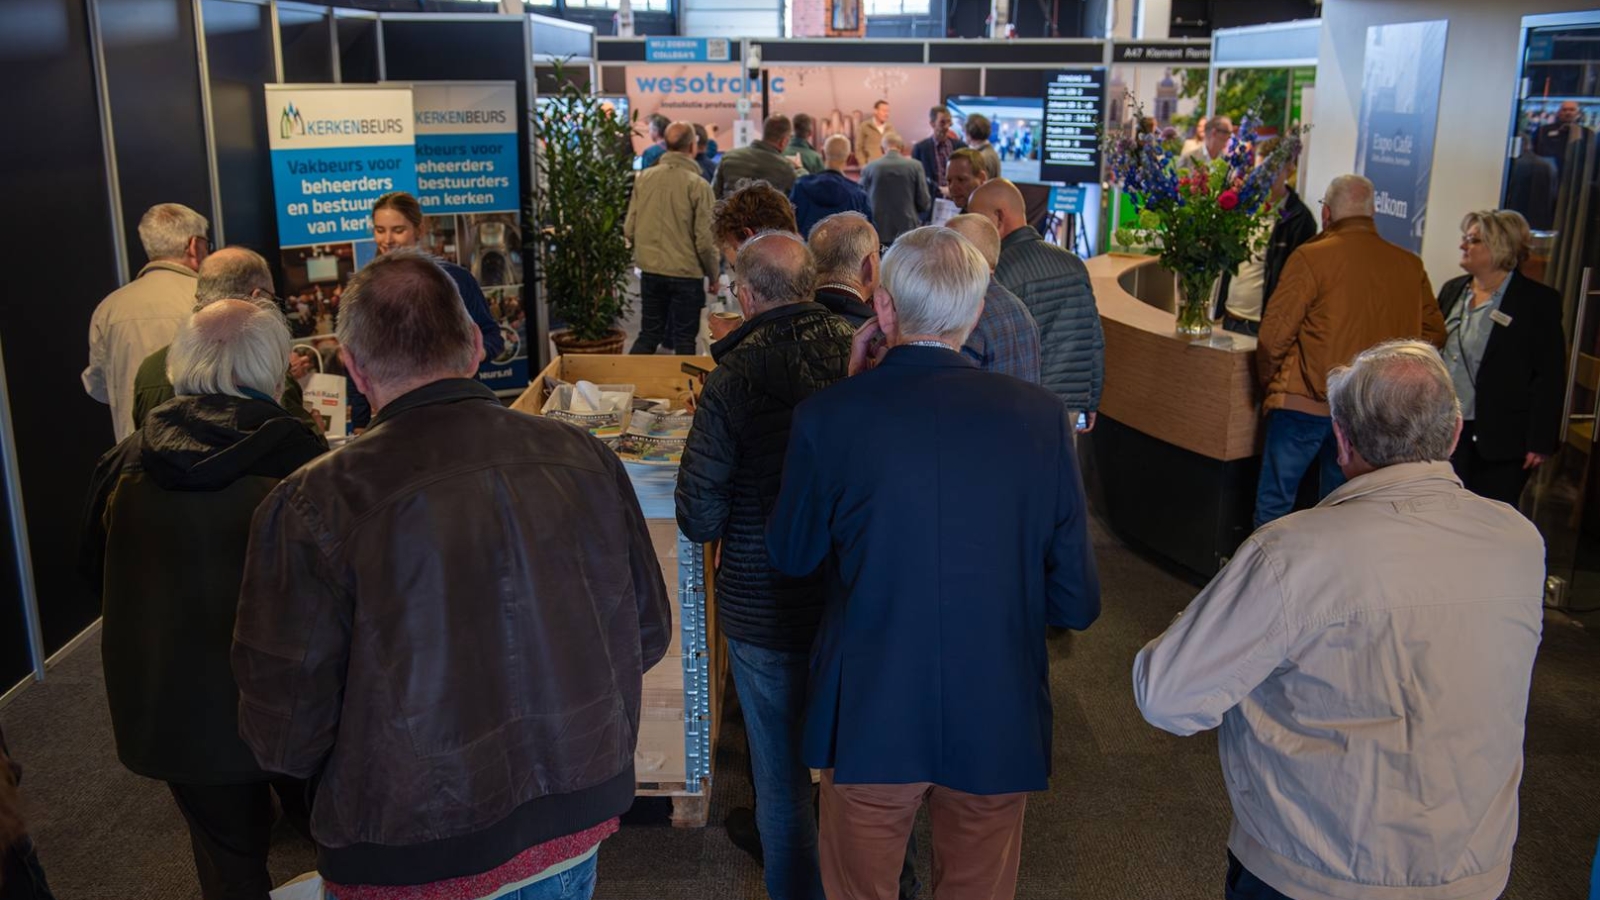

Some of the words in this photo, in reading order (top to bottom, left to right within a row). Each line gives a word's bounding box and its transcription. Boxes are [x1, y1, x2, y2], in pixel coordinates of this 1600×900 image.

[636, 71, 785, 94] wesotronc
[414, 110, 507, 124] KERKENBEURS
[307, 118, 404, 136] KERKENBEURS
[415, 144, 467, 156] kbeurs
[471, 144, 503, 154] voor
[287, 158, 363, 175] Vakbeurs
[367, 158, 402, 171] voor
[301, 175, 394, 195] beheerders
[418, 175, 509, 190] bestuurders
[287, 202, 309, 216] en
[312, 197, 376, 214] bestuur
[443, 192, 495, 206] kerken
[1374, 190, 1408, 219] elkom
[307, 219, 337, 235] van
[340, 214, 375, 232] kerk
[479, 367, 513, 380] eurs.nl
[303, 390, 340, 400] erk&Raad
